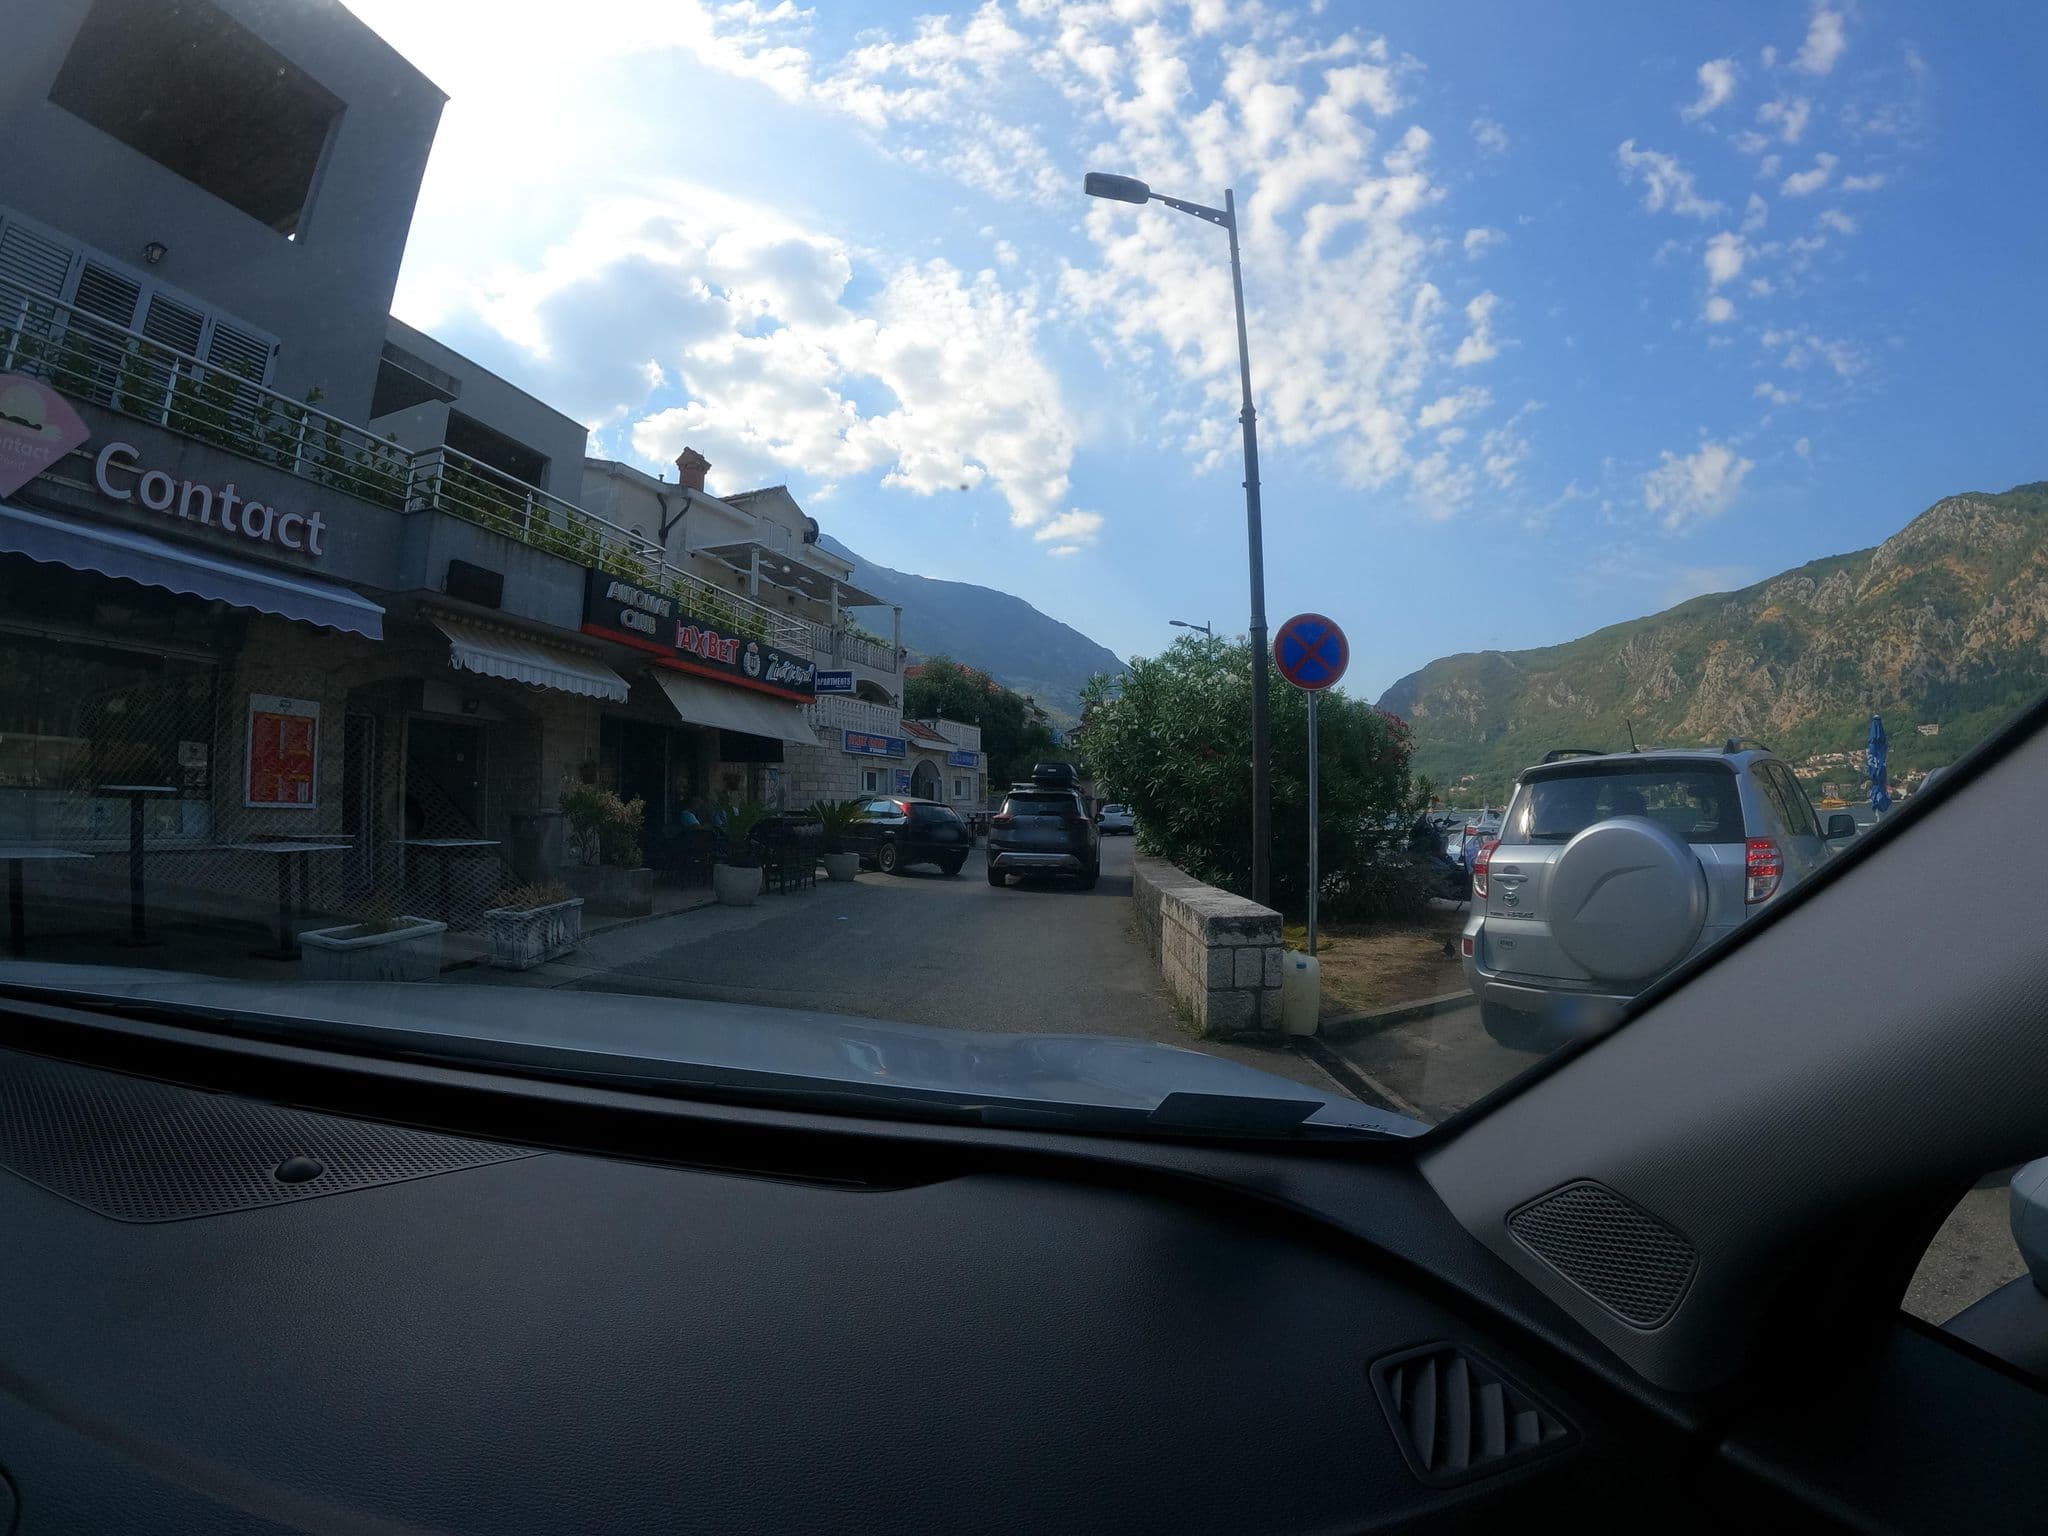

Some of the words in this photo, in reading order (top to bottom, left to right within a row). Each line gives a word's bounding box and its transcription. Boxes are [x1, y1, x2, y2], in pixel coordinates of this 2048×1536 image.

[0, 437, 50, 461] ntact
[95, 441, 327, 556] Contact
[606, 581, 672, 618] AUTOMAT
[620, 608, 657, 635] CLUB
